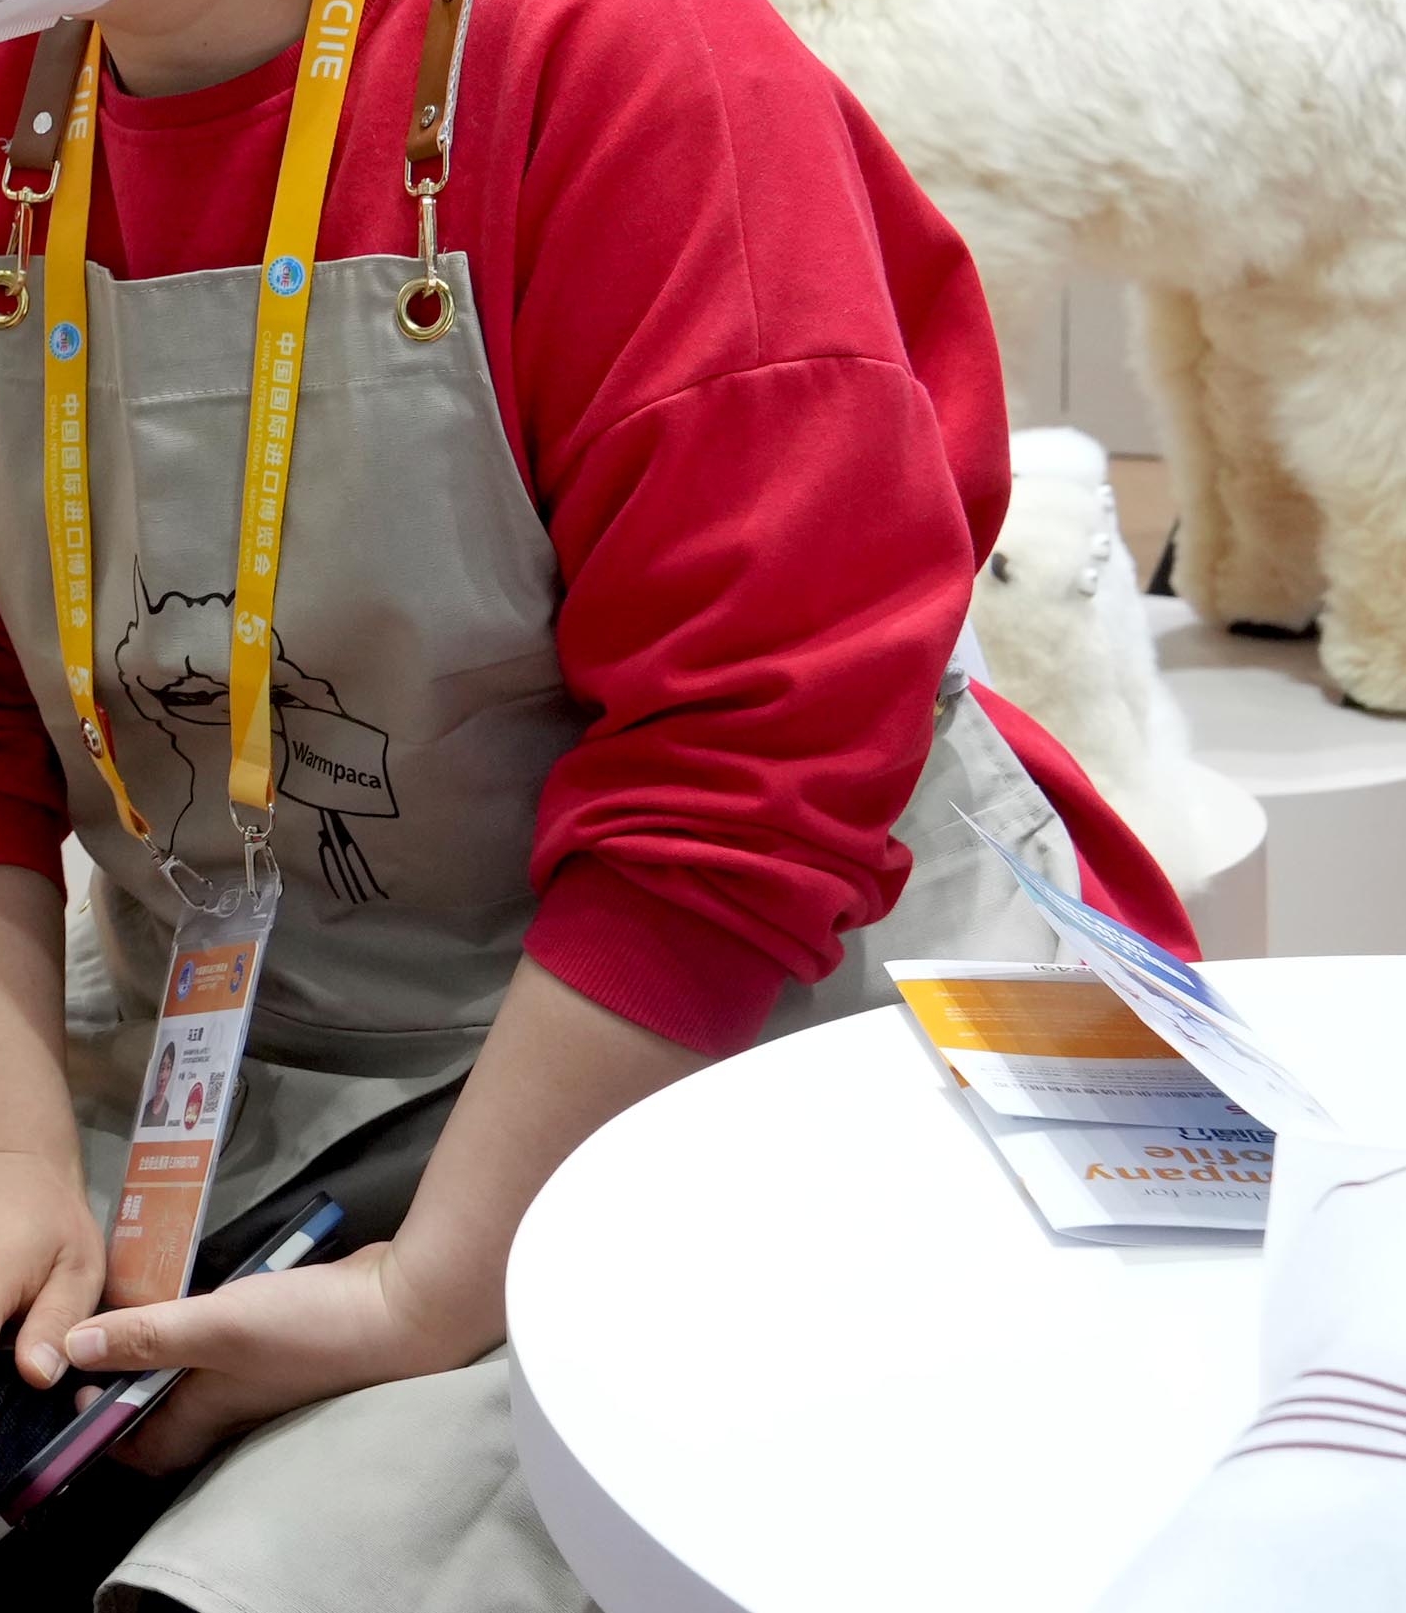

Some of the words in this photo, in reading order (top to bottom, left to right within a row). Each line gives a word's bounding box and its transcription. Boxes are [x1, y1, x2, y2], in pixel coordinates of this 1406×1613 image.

[310, 0, 354, 80] CIIE
[68, 65, 93, 141] CIIE
[260, 330, 272, 372] CHINA
[253, 331, 297, 577] 中国国际进口博览会
[60, 393, 87, 629] 中国国际进口博览会
[292, 740, 382, 790] Warmpaca
[1143, 1145, 1272, 1166] ofile
[1177, 1126, 1277, 1144] 司简介
[1085, 1162, 1273, 1184] mpany
